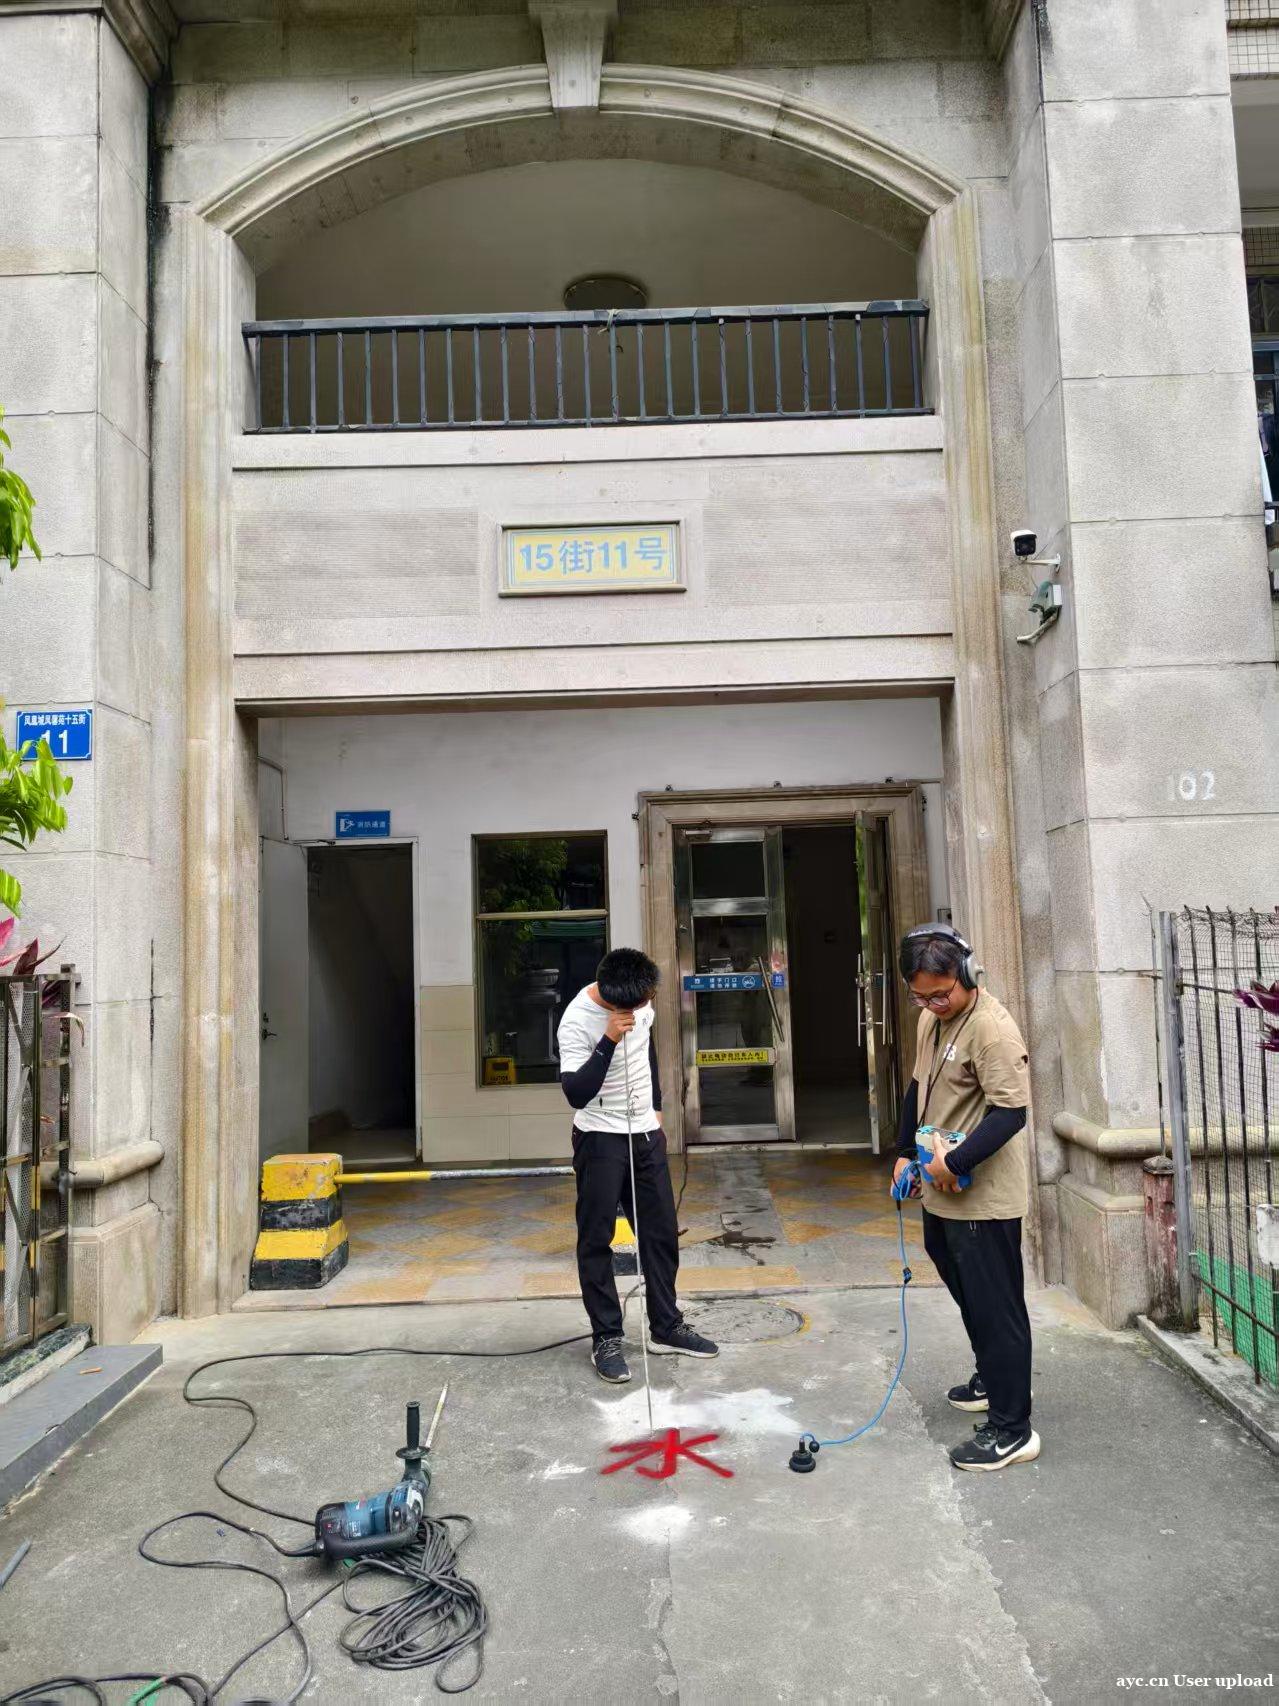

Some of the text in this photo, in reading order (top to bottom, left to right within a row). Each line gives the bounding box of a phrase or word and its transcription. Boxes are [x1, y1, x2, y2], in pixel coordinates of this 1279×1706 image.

[520, 536, 666, 575] 15街11号
[40, 729, 68, 754] 11
[600, 1428, 734, 1479] 水
